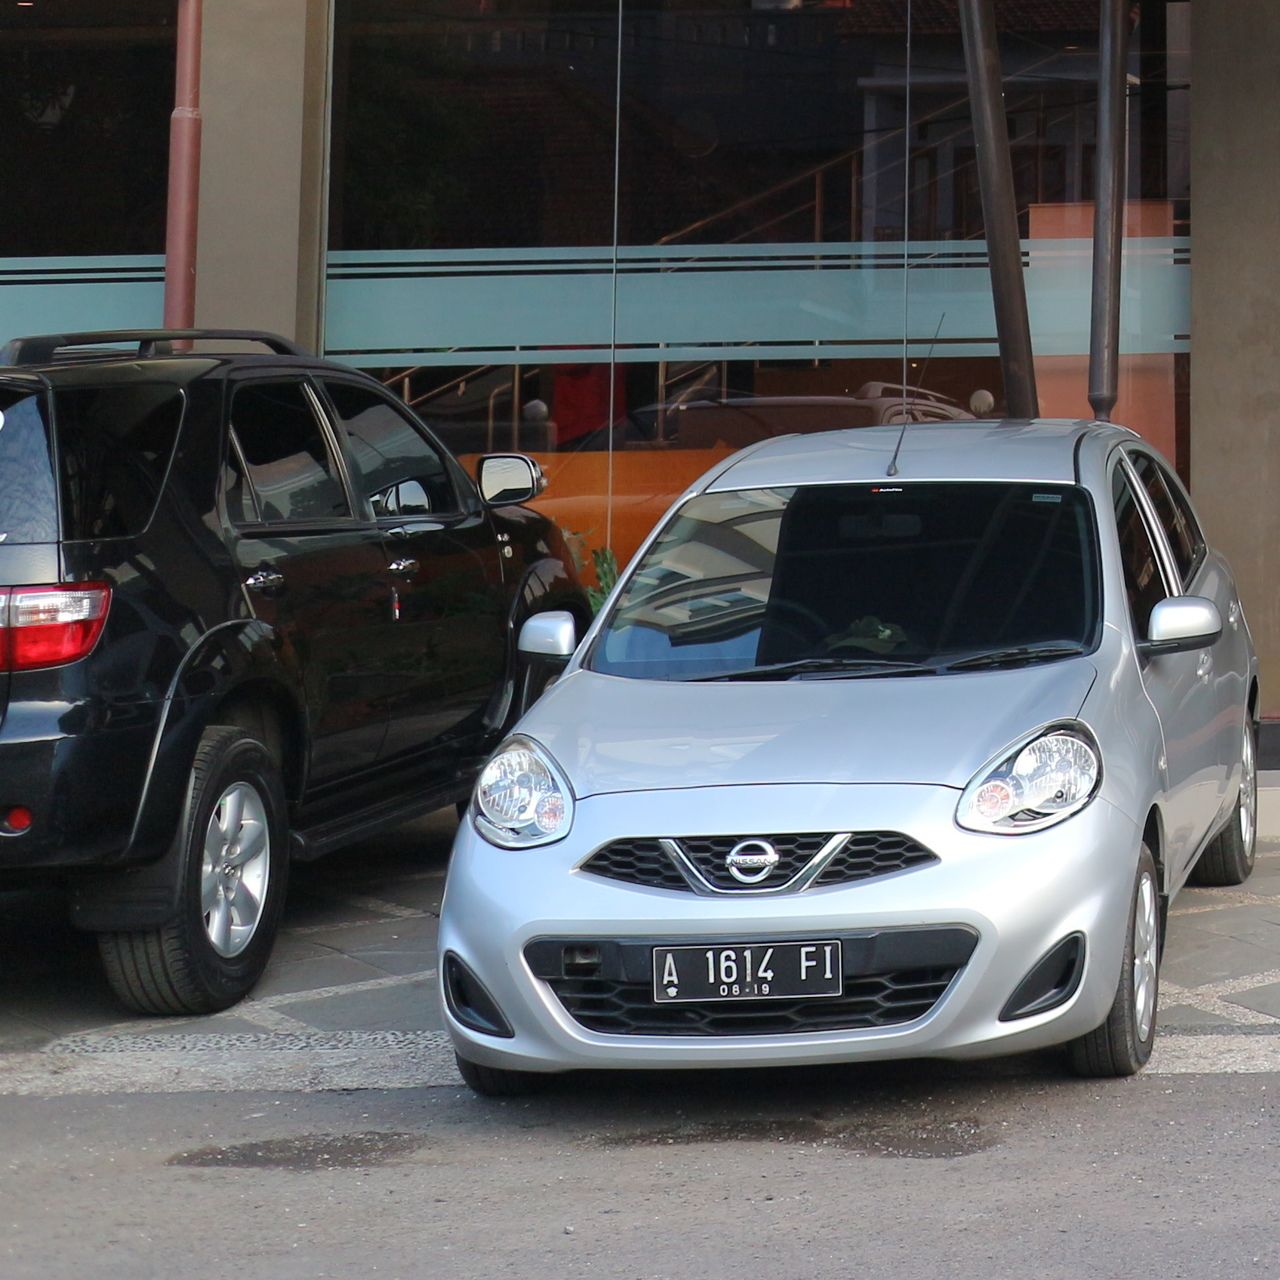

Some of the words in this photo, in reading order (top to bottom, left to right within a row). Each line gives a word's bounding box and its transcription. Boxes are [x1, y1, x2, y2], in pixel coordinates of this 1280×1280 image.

[730, 857, 772, 867] NISSAN
[662, 952, 679, 985] A
[705, 947, 775, 984] 1614
[799, 945, 833, 981] FI
